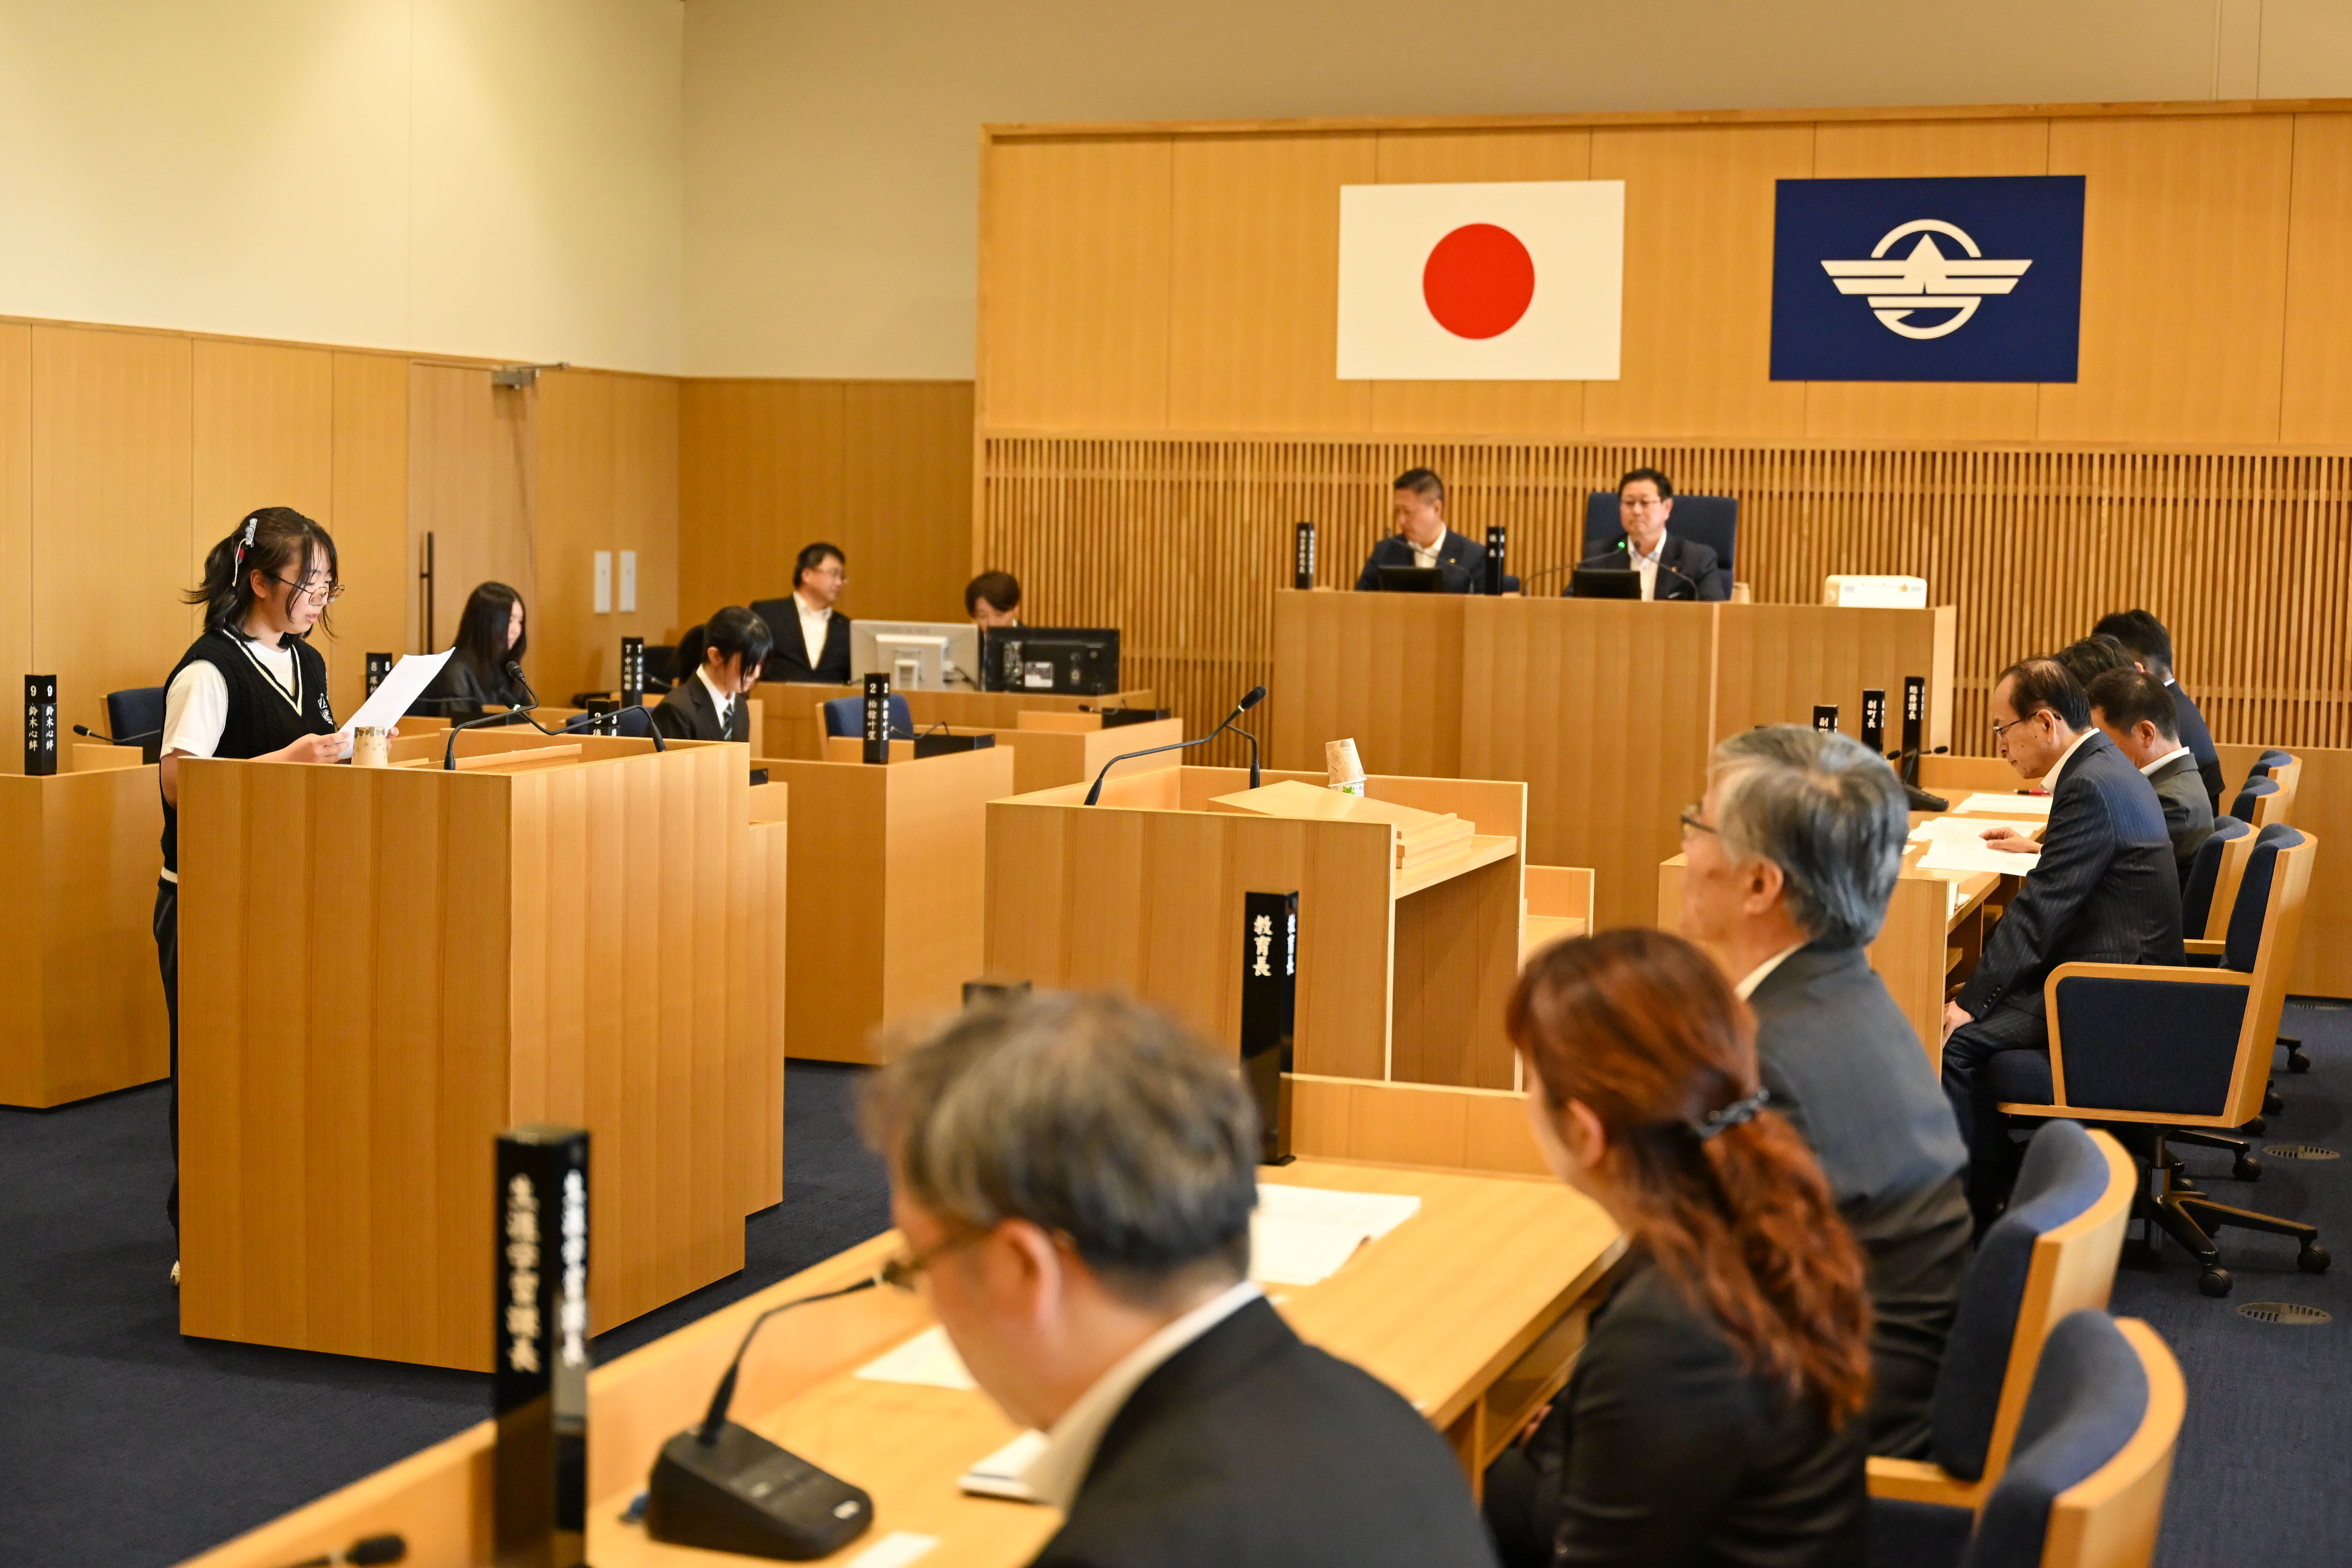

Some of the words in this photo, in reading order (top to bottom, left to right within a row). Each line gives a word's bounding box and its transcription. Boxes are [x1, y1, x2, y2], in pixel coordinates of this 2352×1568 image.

[371, 661, 378, 672] 8
[385, 661, 390, 672] 8
[30, 686, 37, 696] 9
[47, 686, 52, 697] 9
[870, 683, 877, 693] 2
[884, 682, 889, 693] 2
[1867, 700, 1877, 728] 副町長
[1252, 914, 1273, 976] 教育長
[1286, 913, 1296, 976] 教育長
